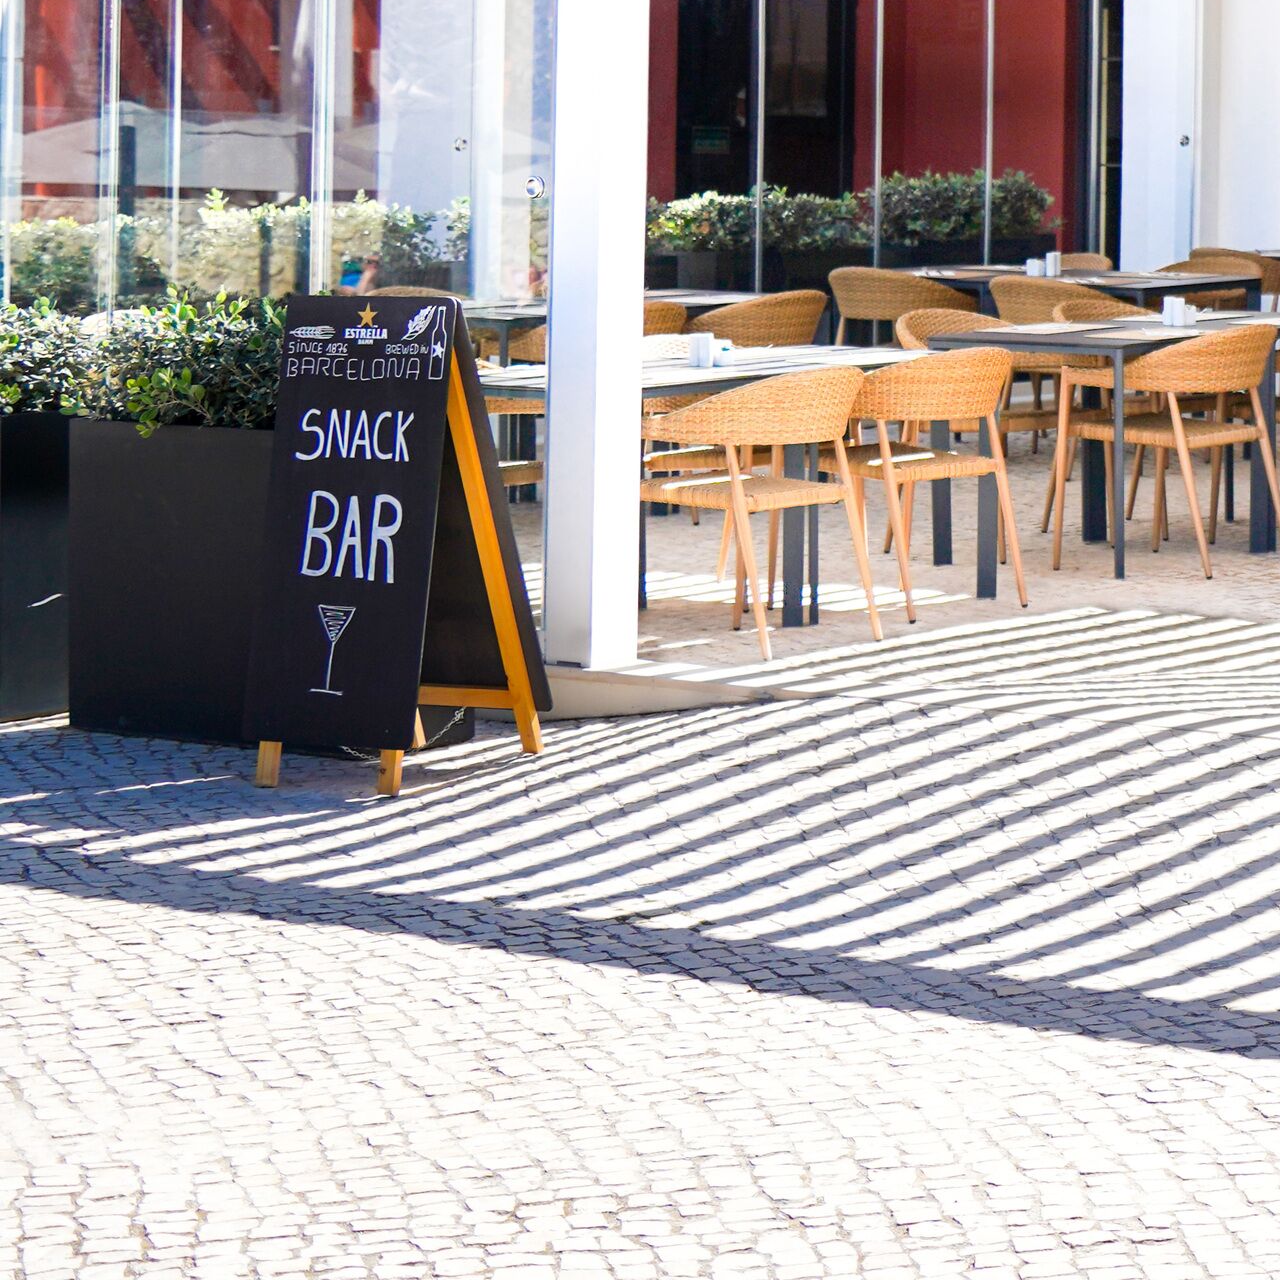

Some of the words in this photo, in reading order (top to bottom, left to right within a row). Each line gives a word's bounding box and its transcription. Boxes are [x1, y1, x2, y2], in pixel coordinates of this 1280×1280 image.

[344, 328, 388, 339] ESTRELLA
[326, 343, 348, 354] 1876
[385, 344, 419, 355] BREWED
[286, 357, 421, 381] BARCELONA
[295, 408, 415, 463] SNACK
[300, 489, 404, 585] BAR
